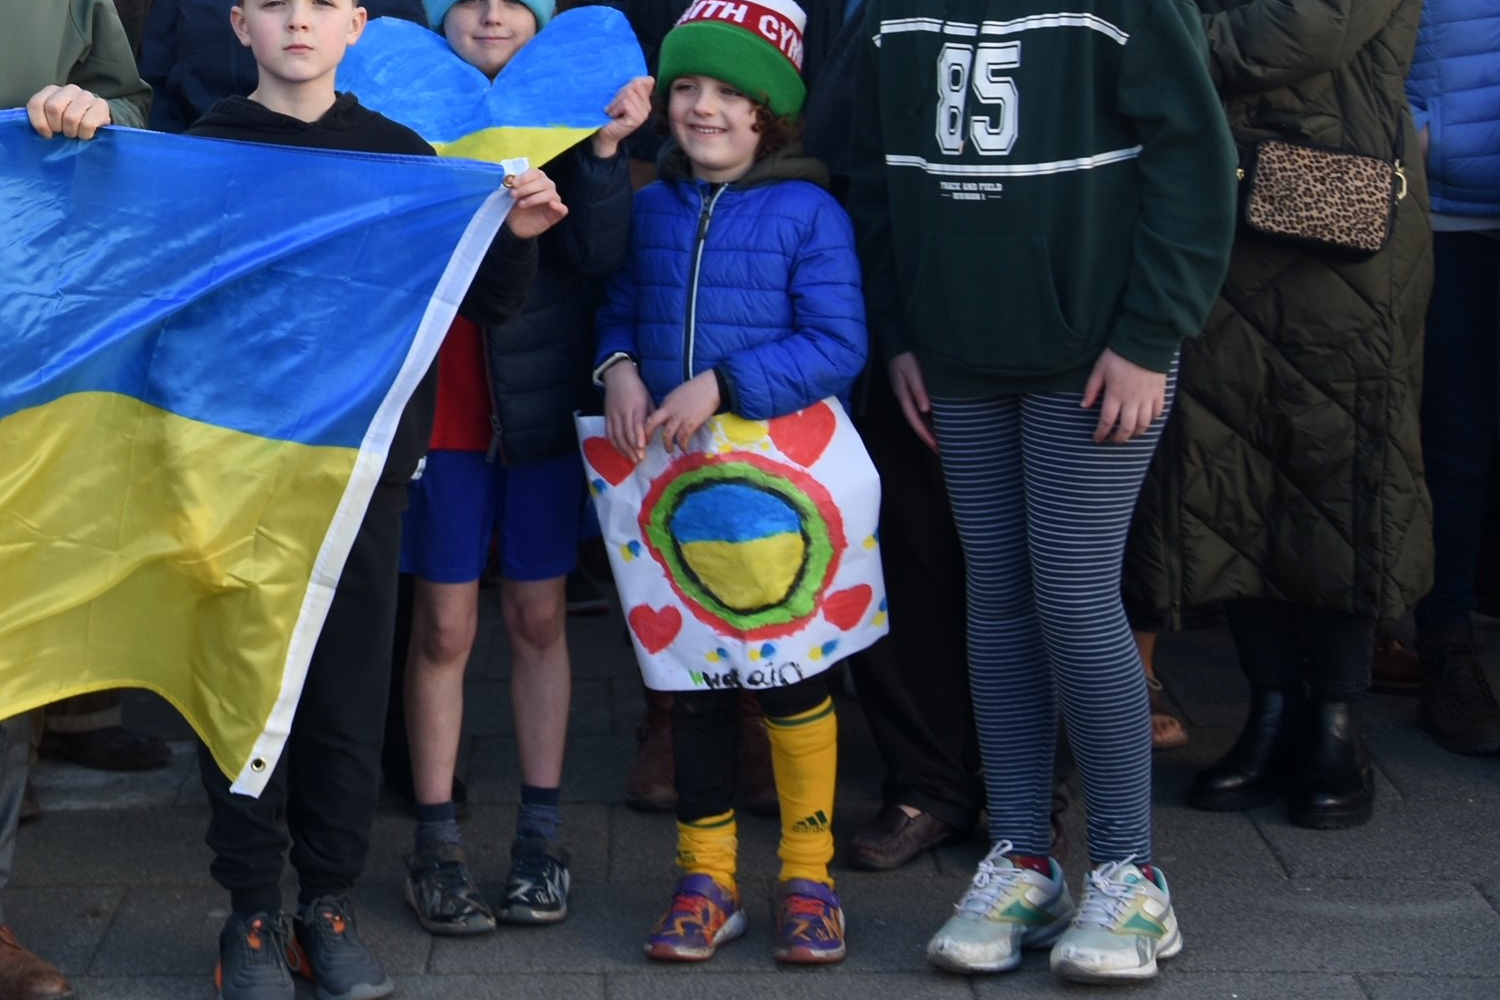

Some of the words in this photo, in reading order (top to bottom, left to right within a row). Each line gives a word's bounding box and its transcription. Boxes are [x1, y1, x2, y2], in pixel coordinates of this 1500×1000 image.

[935, 40, 1022, 156] 85
[962, 182, 978, 191] AND
[978, 182, 1003, 192] FIELD
